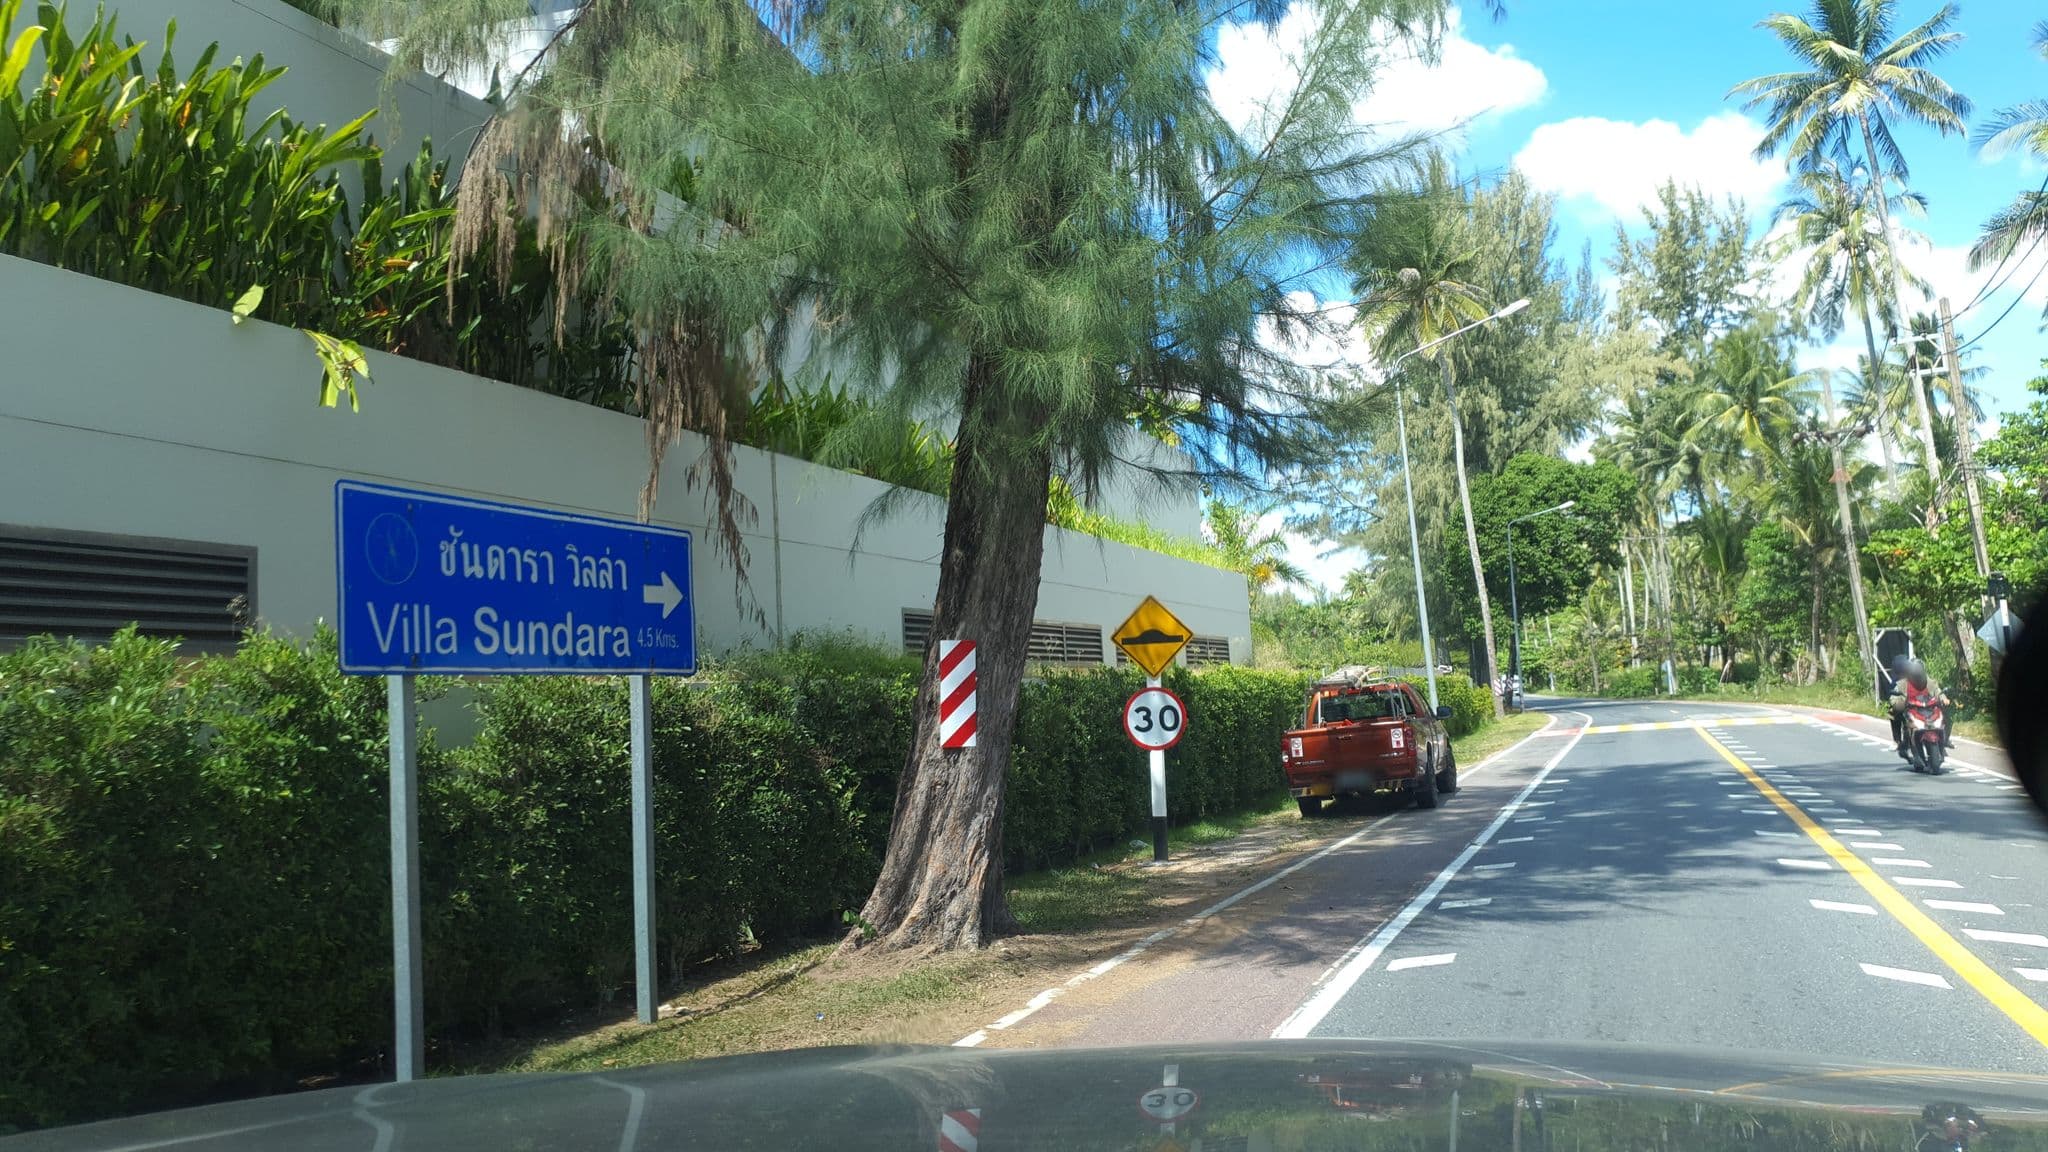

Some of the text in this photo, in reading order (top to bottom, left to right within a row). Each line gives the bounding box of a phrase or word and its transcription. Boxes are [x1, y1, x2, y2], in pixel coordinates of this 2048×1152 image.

[565, 543, 628, 591] วิลล่า
[366, 601, 680, 658] Villa Sundara 4.5 Kms.
[1134, 704, 1180, 733] 30
